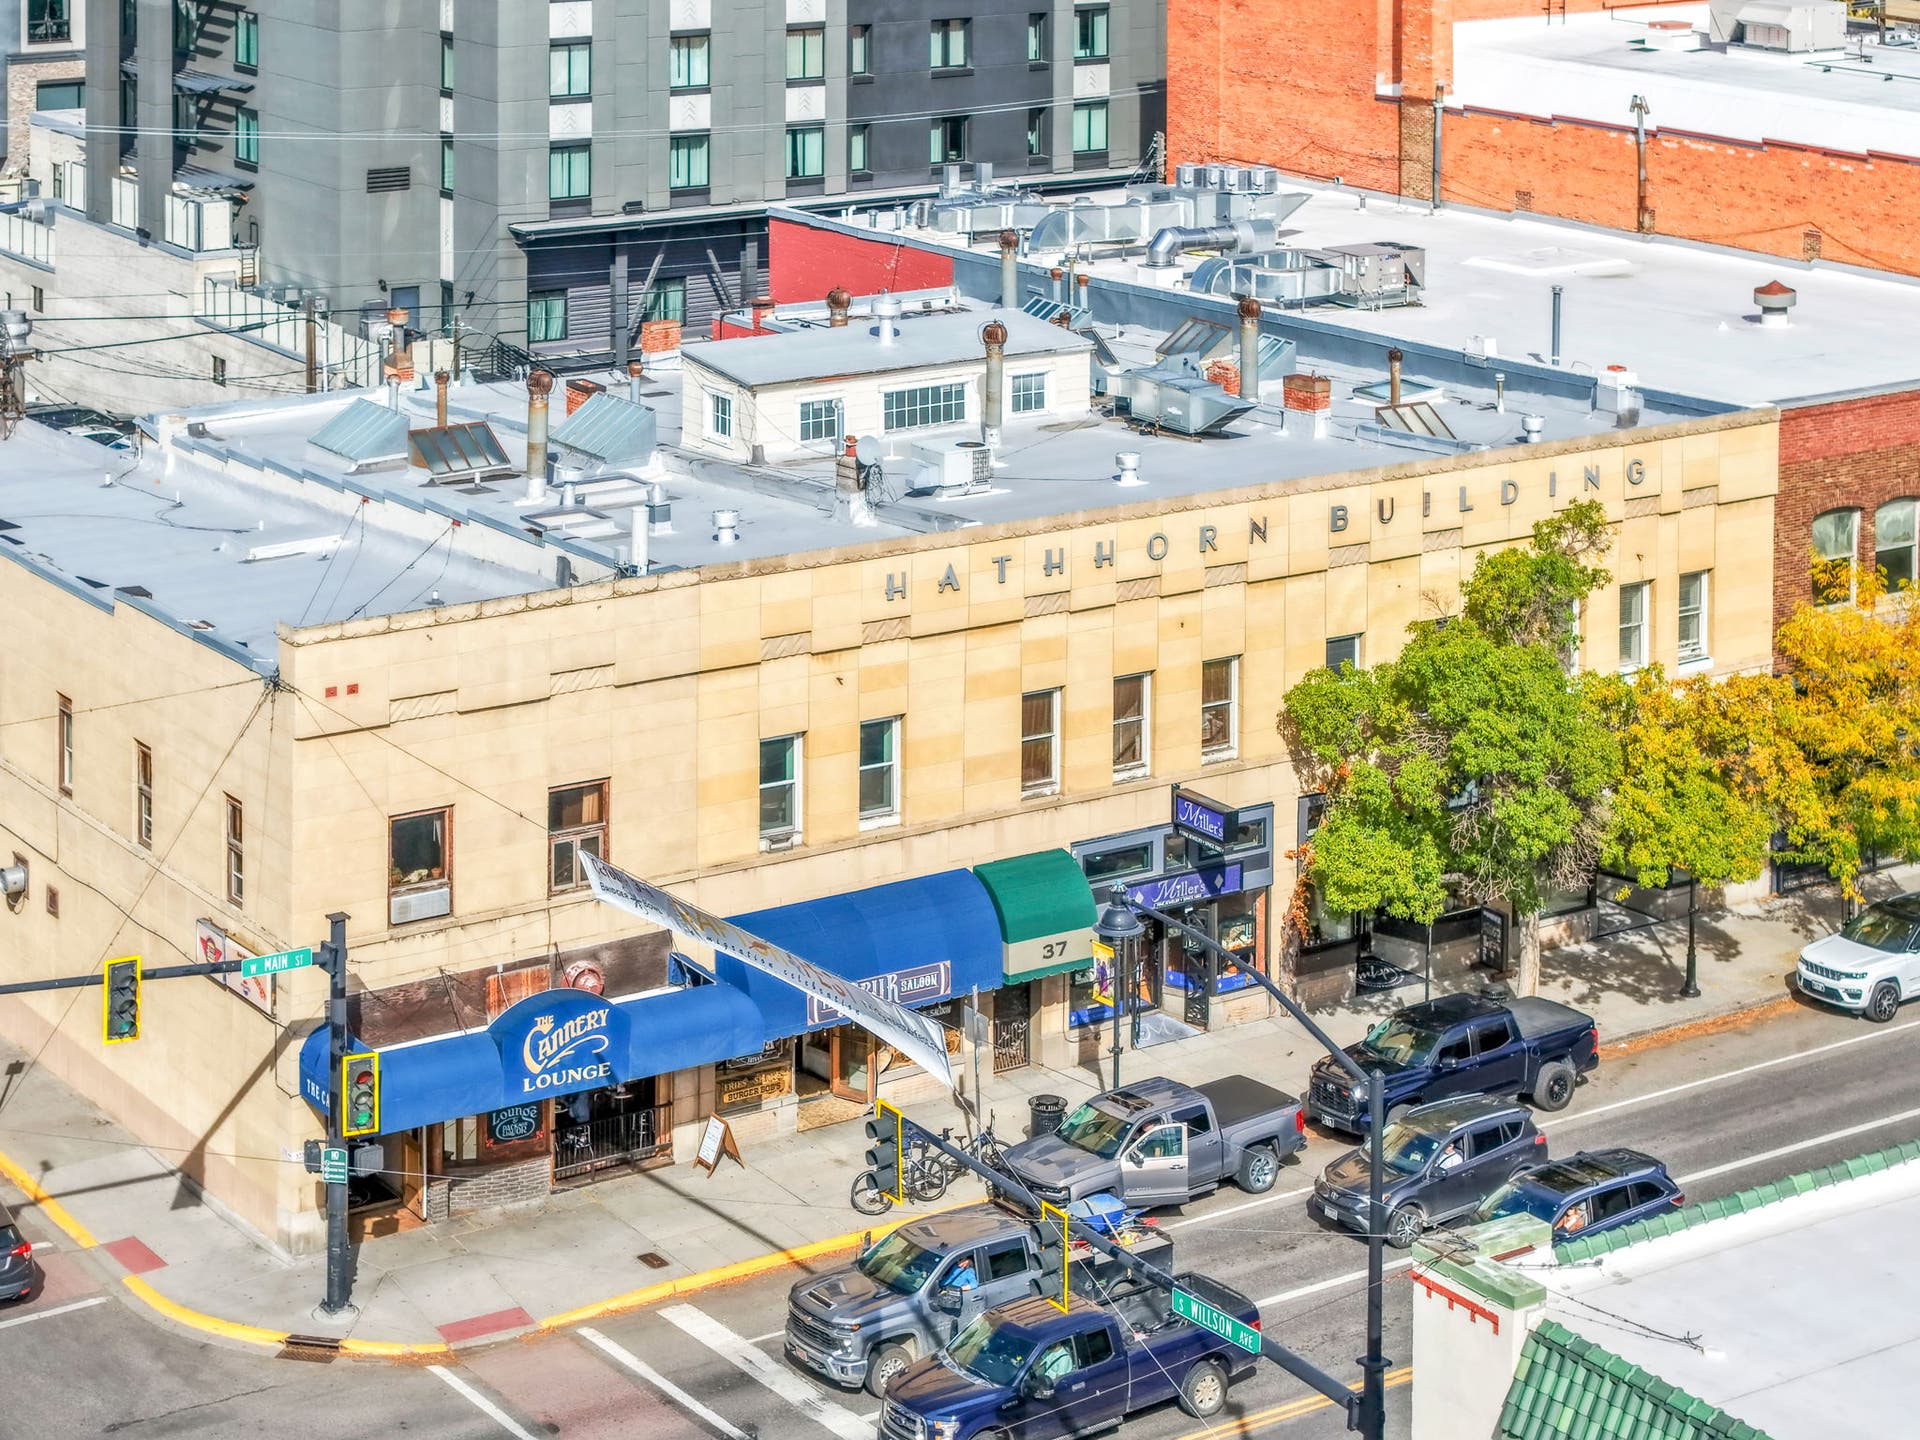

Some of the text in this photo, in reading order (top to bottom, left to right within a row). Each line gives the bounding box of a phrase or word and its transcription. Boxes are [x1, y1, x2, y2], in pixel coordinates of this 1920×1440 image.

[885, 458, 1646, 601] HATHHORN BUILDING
[1180, 801, 1224, 837] Miller's
[1152, 877, 1206, 902] Miller's
[1043, 940, 1068, 959] 37
[250, 954, 303, 974] W MAIN ST
[901, 973, 938, 992] SALOON
[534, 1015, 554, 1026] THE
[523, 1009, 610, 1074] CANNERY
[523, 1062, 611, 1093] LOUNGE
[307, 1079, 320, 1100] THE
[728, 1083, 781, 1101] BURGER BOB'S
[1179, 1298, 1254, 1349] S WILLSON AVE
